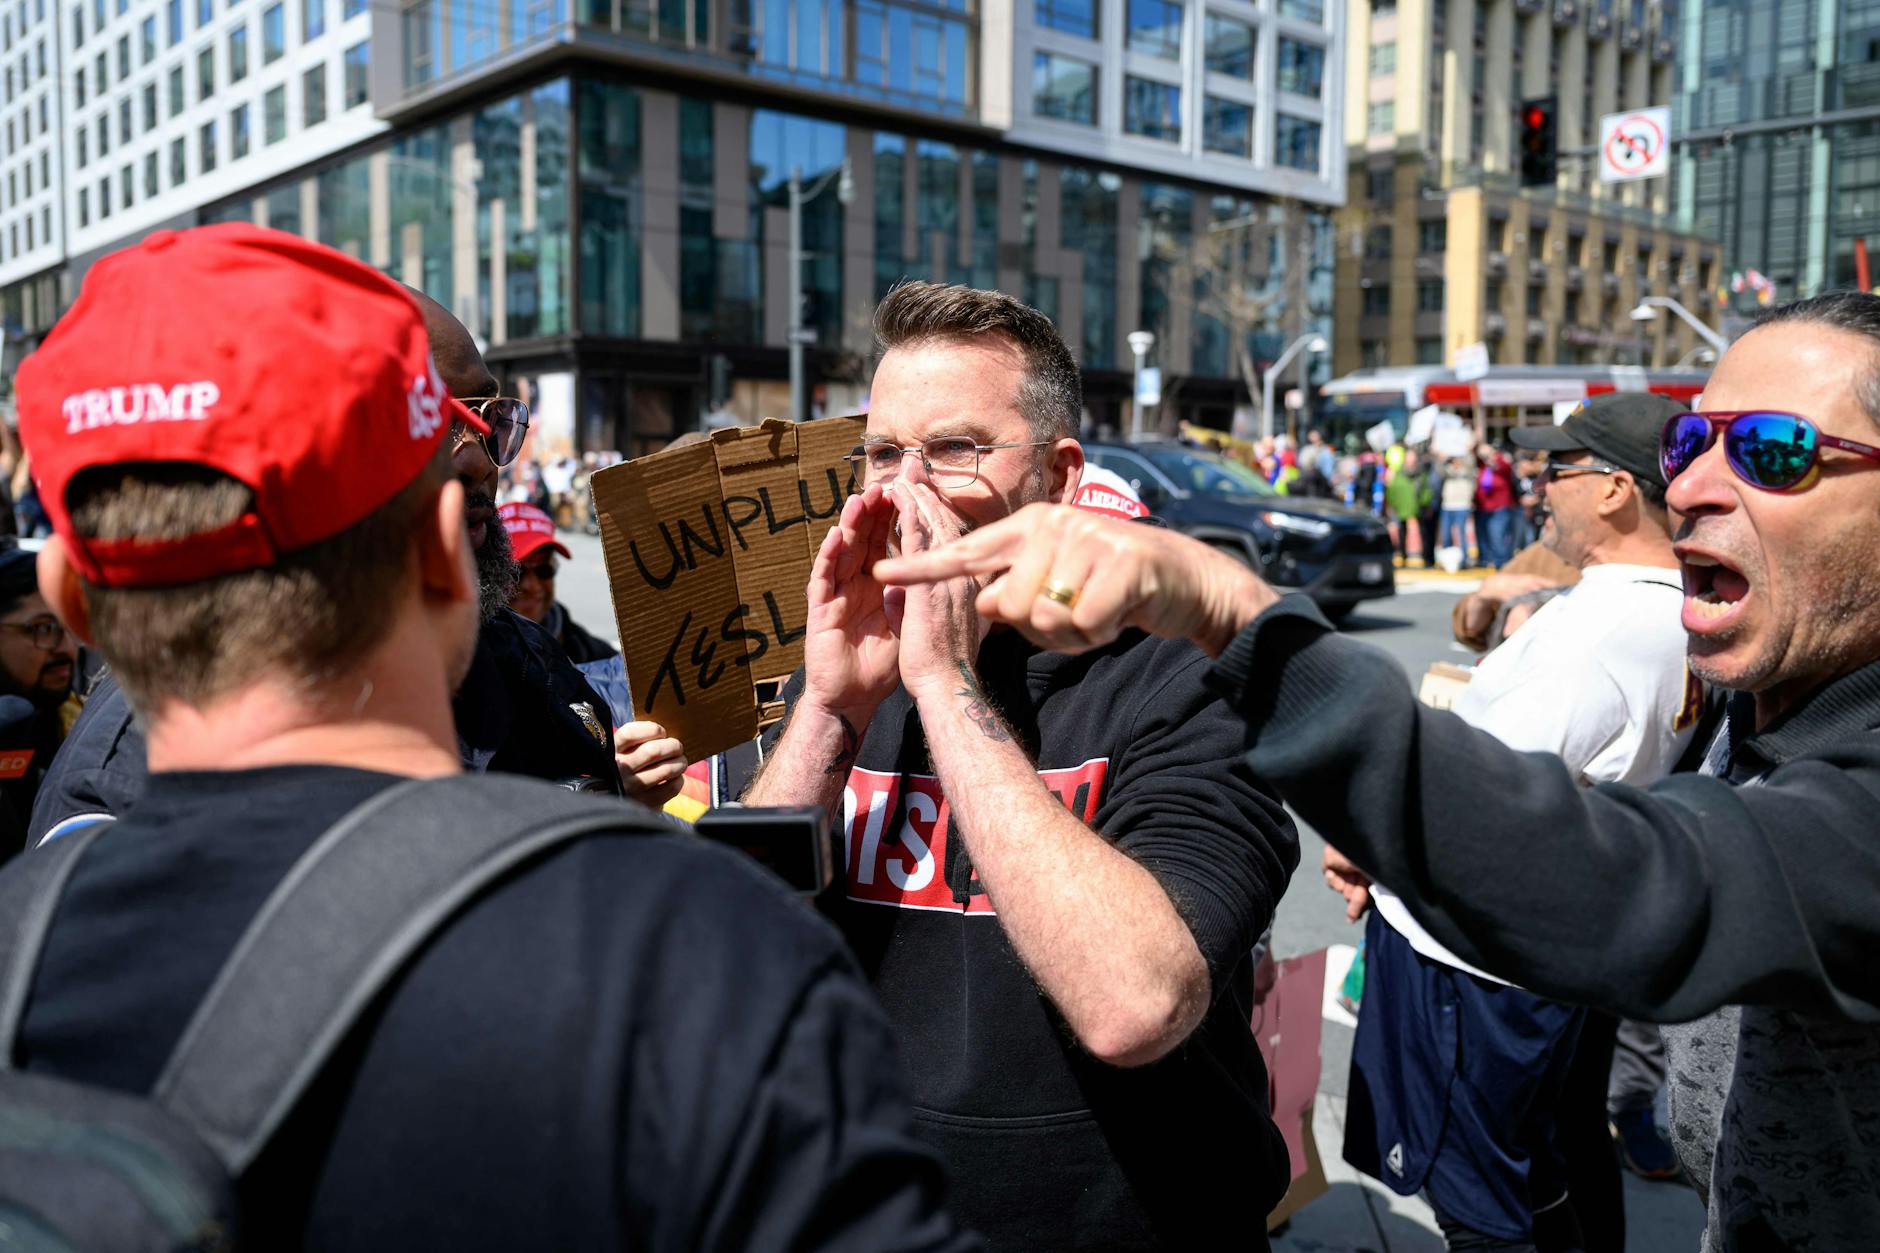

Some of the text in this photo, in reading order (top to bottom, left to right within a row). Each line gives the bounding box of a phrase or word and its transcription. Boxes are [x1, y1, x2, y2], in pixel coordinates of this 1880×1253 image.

[62, 381, 220, 434] TRUMP
[1077, 489, 1142, 518] AMERICA
[643, 590, 806, 714] TESL
